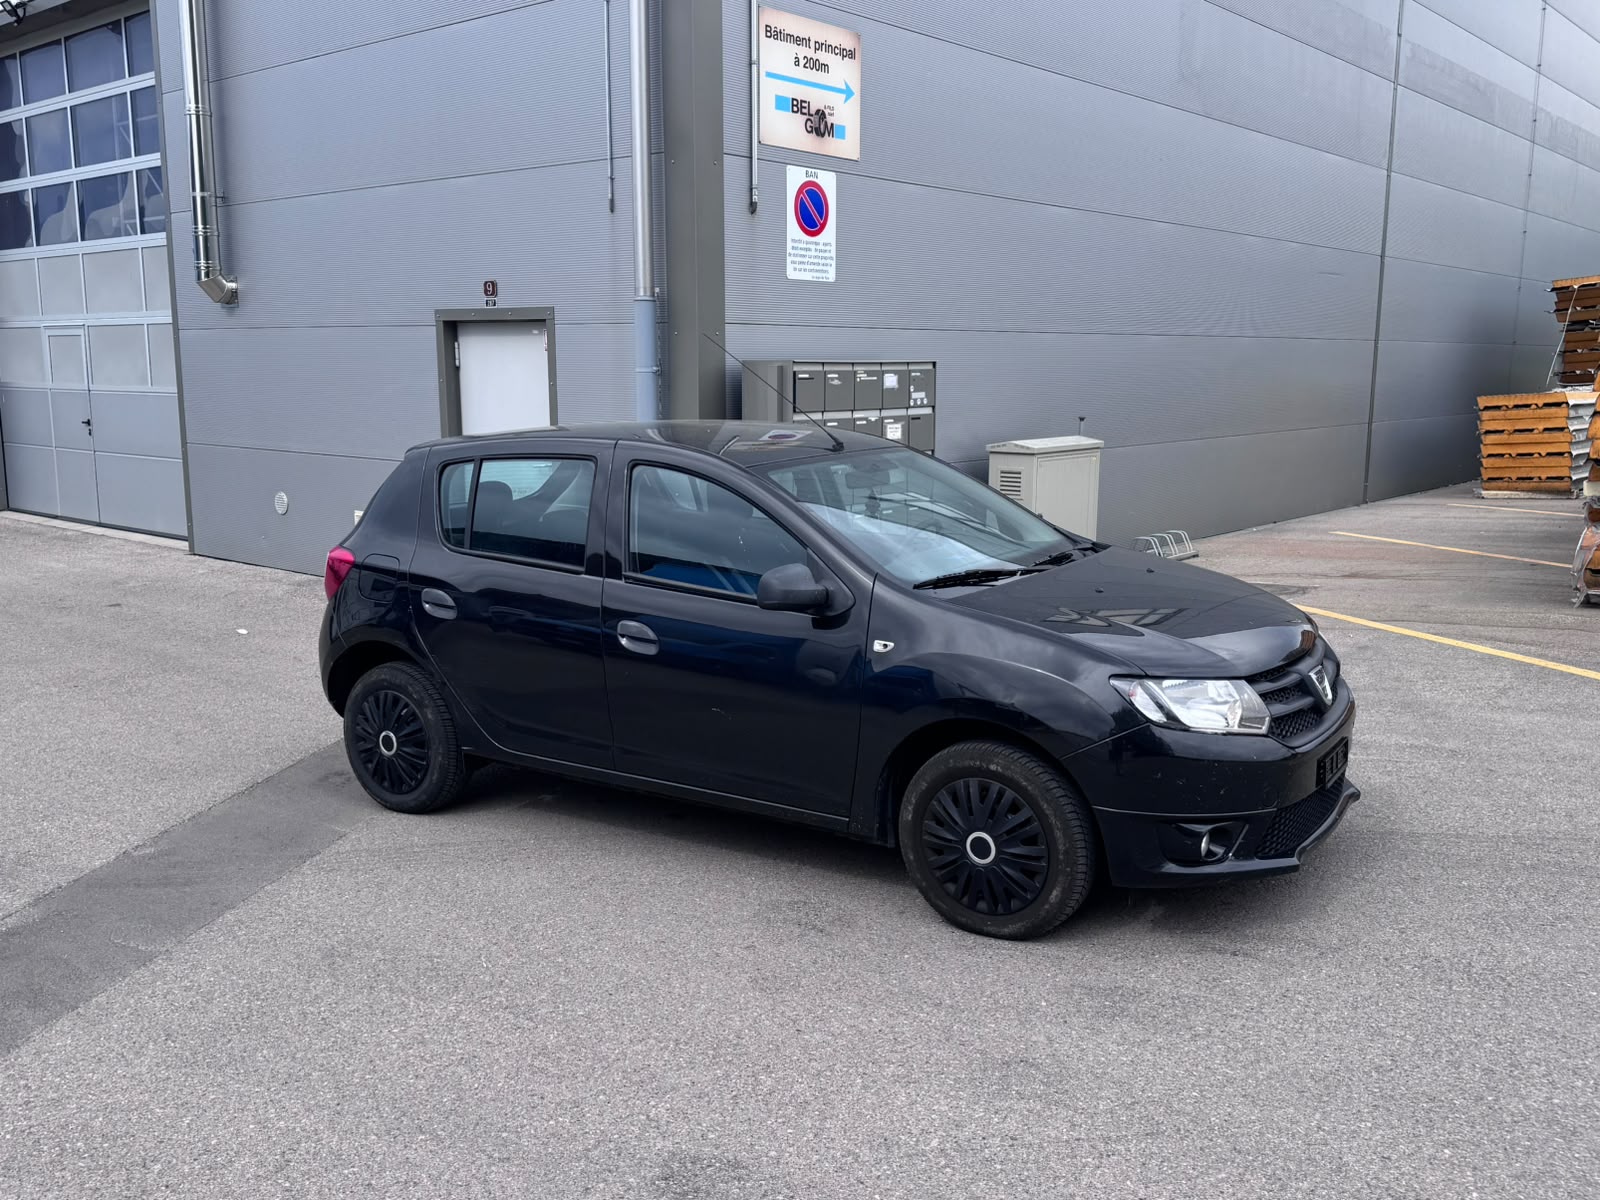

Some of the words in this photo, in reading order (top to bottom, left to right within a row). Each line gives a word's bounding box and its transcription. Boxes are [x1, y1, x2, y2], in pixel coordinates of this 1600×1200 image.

[765, 24, 812, 49] Bâtiment
[814, 40, 856, 61] principal
[794, 52, 800, 67] à
[803, 55, 830, 75] 200m
[805, 170, 819, 179] BAN
[486, 282, 493, 295] 9
